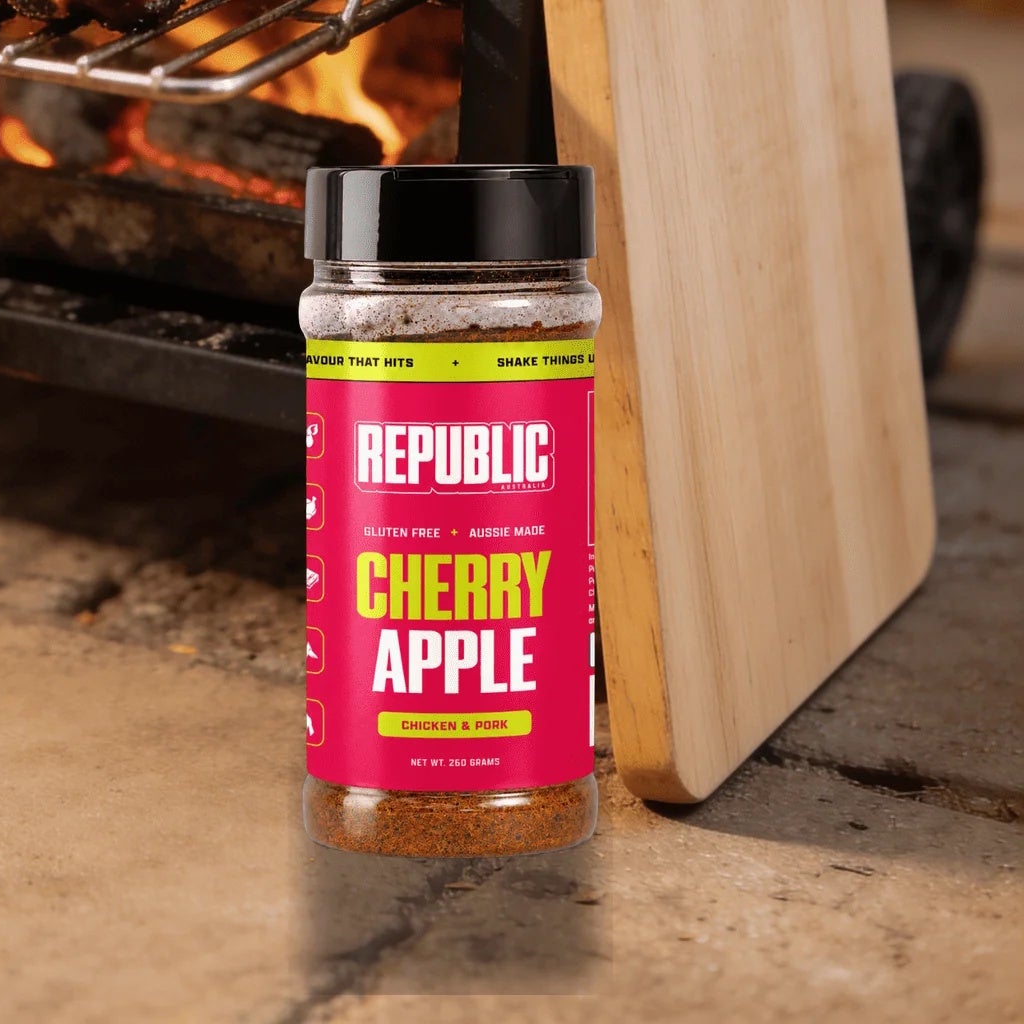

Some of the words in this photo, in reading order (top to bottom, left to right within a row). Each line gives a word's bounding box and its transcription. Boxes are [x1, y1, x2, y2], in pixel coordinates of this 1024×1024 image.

[306, 355, 344, 366] AVOUR
[348, 356, 380, 367] THAT
[384, 358, 414, 368] HITS
[497, 356, 538, 367] SHAKE
[542, 354, 584, 366] THINGS
[358, 423, 549, 485] REPUBLIC
[501, 482, 546, 490] AUSTRALIA
[363, 526, 408, 538] GLUTEN
[412, 527, 441, 538] FREE
[469, 526, 510, 538] AUSSIE
[514, 525, 545, 537] MADE
[356, 550, 552, 621] CHERRY
[372, 626, 537, 694] APPLE
[401, 720, 457, 731] CHICKEN
[461, 720, 471, 731] &
[475, 719, 508, 730] PORK
[410, 758, 427, 767] NET
[430, 758, 446, 767] WT.
[449, 758, 467, 767] 260
[469, 757, 500, 767] GRAMS
